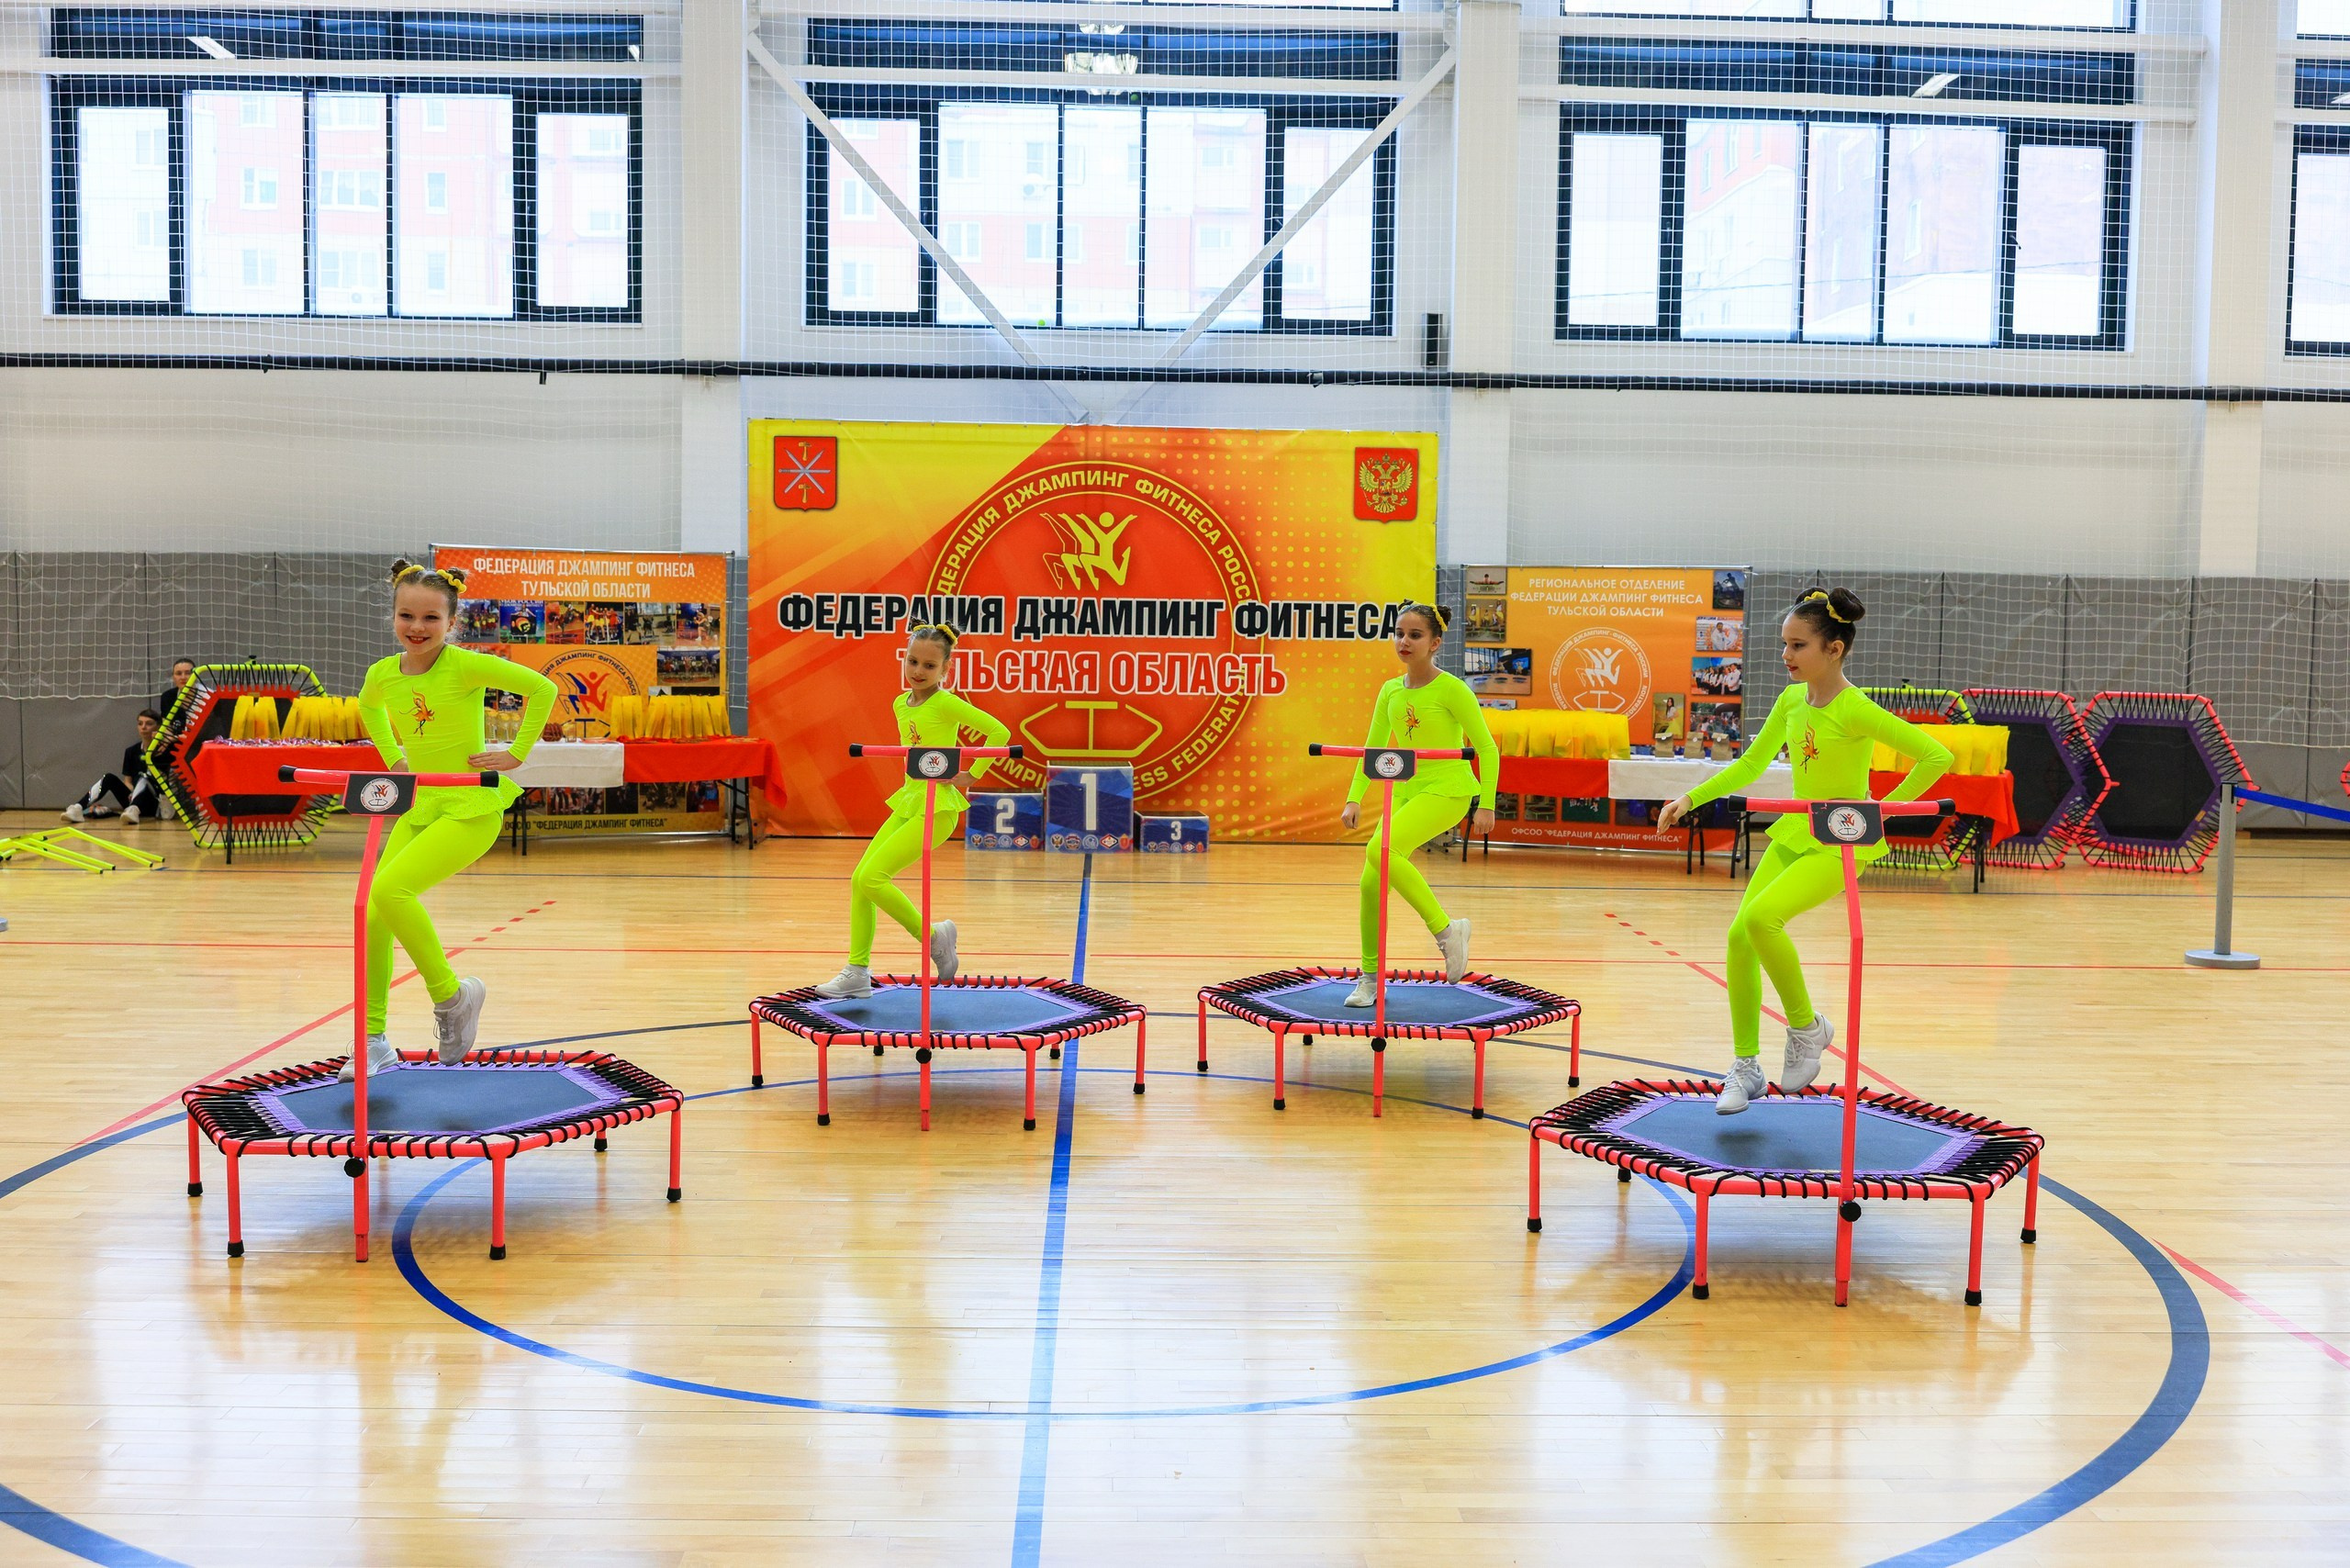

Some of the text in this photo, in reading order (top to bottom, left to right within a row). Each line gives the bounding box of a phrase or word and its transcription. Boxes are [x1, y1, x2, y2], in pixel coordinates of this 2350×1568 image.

[936, 470, 1251, 602] ДЕРАЦИЯ ДЖАМПИНГ ФИТНЕСА РОСС
[474, 557, 695, 577] ФЕДЕРАЦИЯ ДЖАМПИНГ ФИТНЕСА
[521, 579, 651, 598] ТУЛЬСКОЙ ОБЛАСТИ
[1528, 578, 1685, 590] РЕГИОНАЛЬНОЕ ОТДЕЛЕНИЕ
[1510, 592, 1704, 604] ФЕДЕРАЦИИ ДЖАМПИНГ ФИТНЕСА
[778, 592, 1003, 639] ФЕДЕРАЦИЯ
[1013, 596, 1225, 641] ДЖАМПИНГ
[1547, 605, 1664, 617] ТУЛЬСКОЙ ОБЛАСТИ
[554, 652, 637, 695] ДЖАМПИНГ ФИТНЕСА РОСС
[896, 648, 1287, 696] ЛЬСКАЯ ОБЛАСТЬ
[1171, 691, 1243, 772] FEDERAT
[1080, 773, 1097, 831] 1
[585, 819, 629, 830] ДЖАМПИНГ
[995, 799, 1014, 834] 2
[1170, 821, 1181, 841] 3
[1595, 832, 1640, 841] ДЖАМПИНГ
